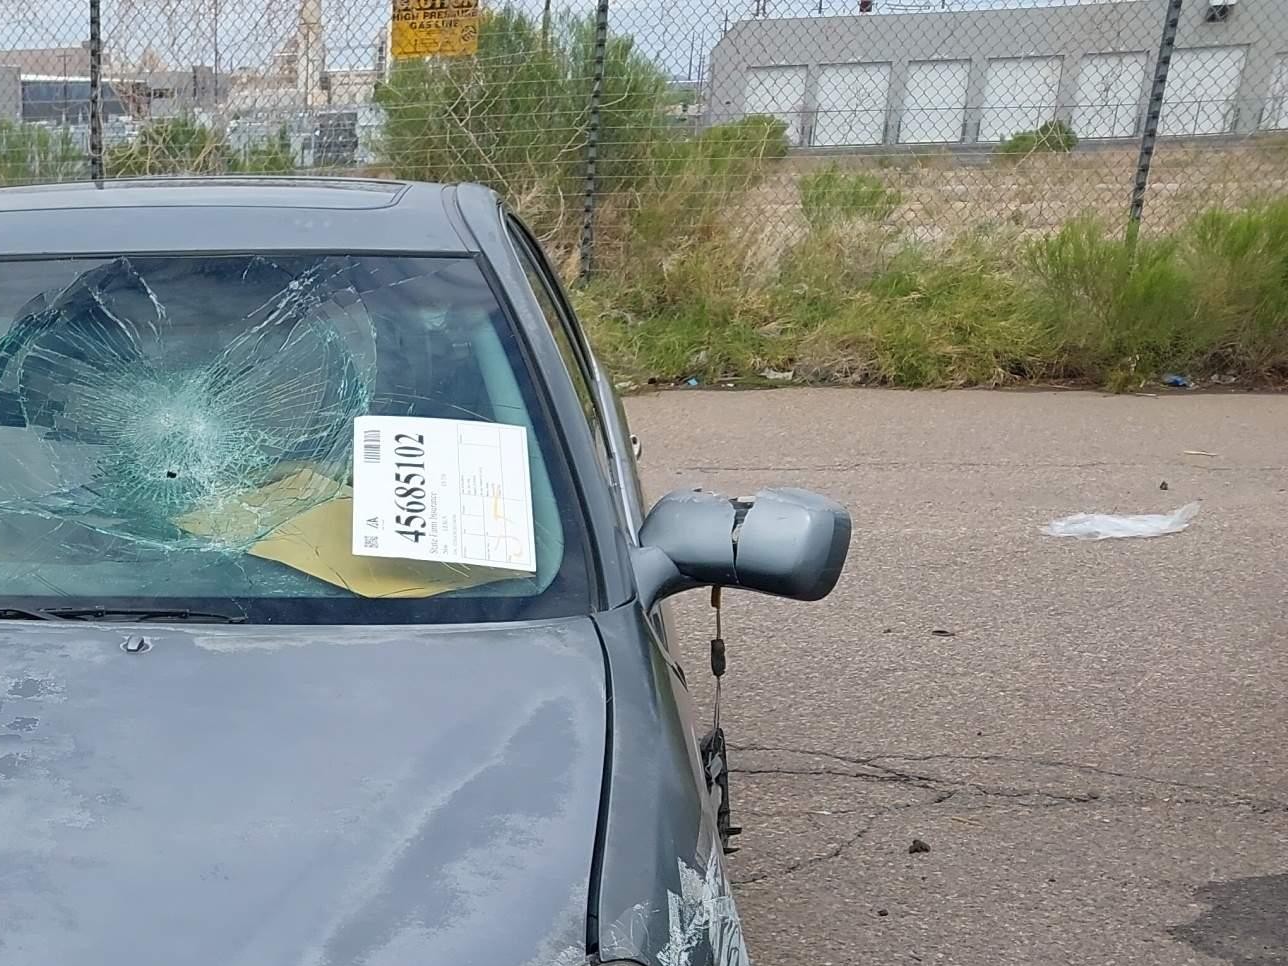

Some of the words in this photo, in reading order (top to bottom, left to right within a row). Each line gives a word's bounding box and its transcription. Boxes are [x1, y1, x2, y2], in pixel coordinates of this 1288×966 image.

[392, 12, 420, 22] HIGH
[409, 21, 432, 30] GAS
[394, 433, 426, 544] 45685102
